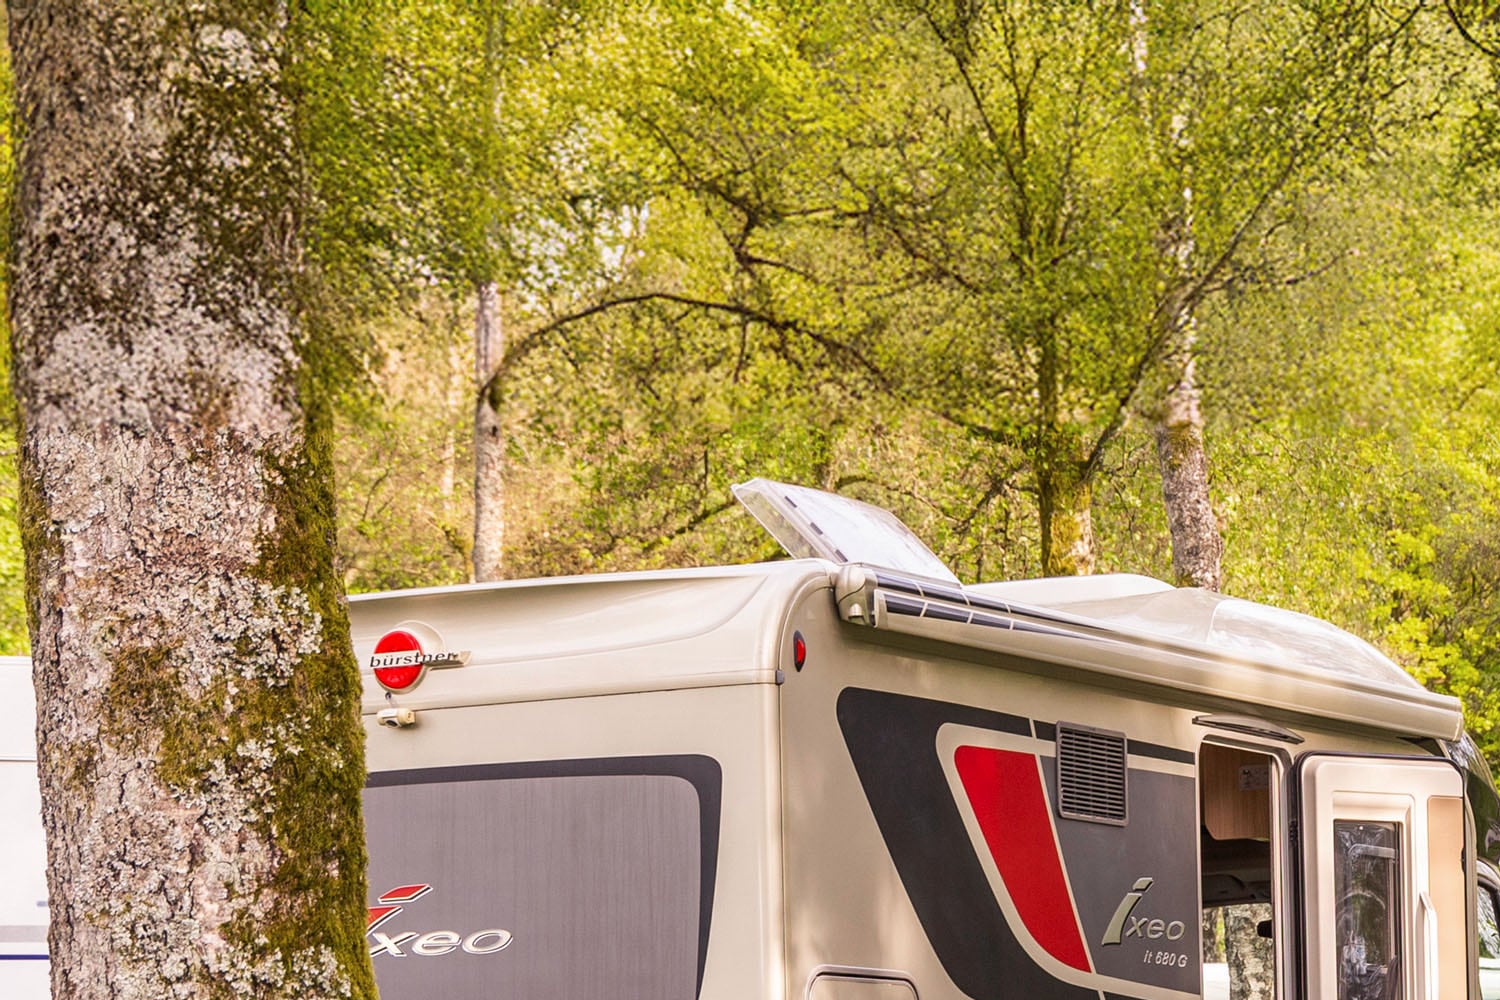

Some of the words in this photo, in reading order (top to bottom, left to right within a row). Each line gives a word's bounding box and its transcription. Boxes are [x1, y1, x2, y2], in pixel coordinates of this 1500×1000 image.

[369, 651, 457, 668] bürstner
[1101, 876, 1186, 947] ixeo
[1143, 949, 1153, 964] it
[1155, 951, 1176, 966] 680
[1177, 954, 1188, 968] G
